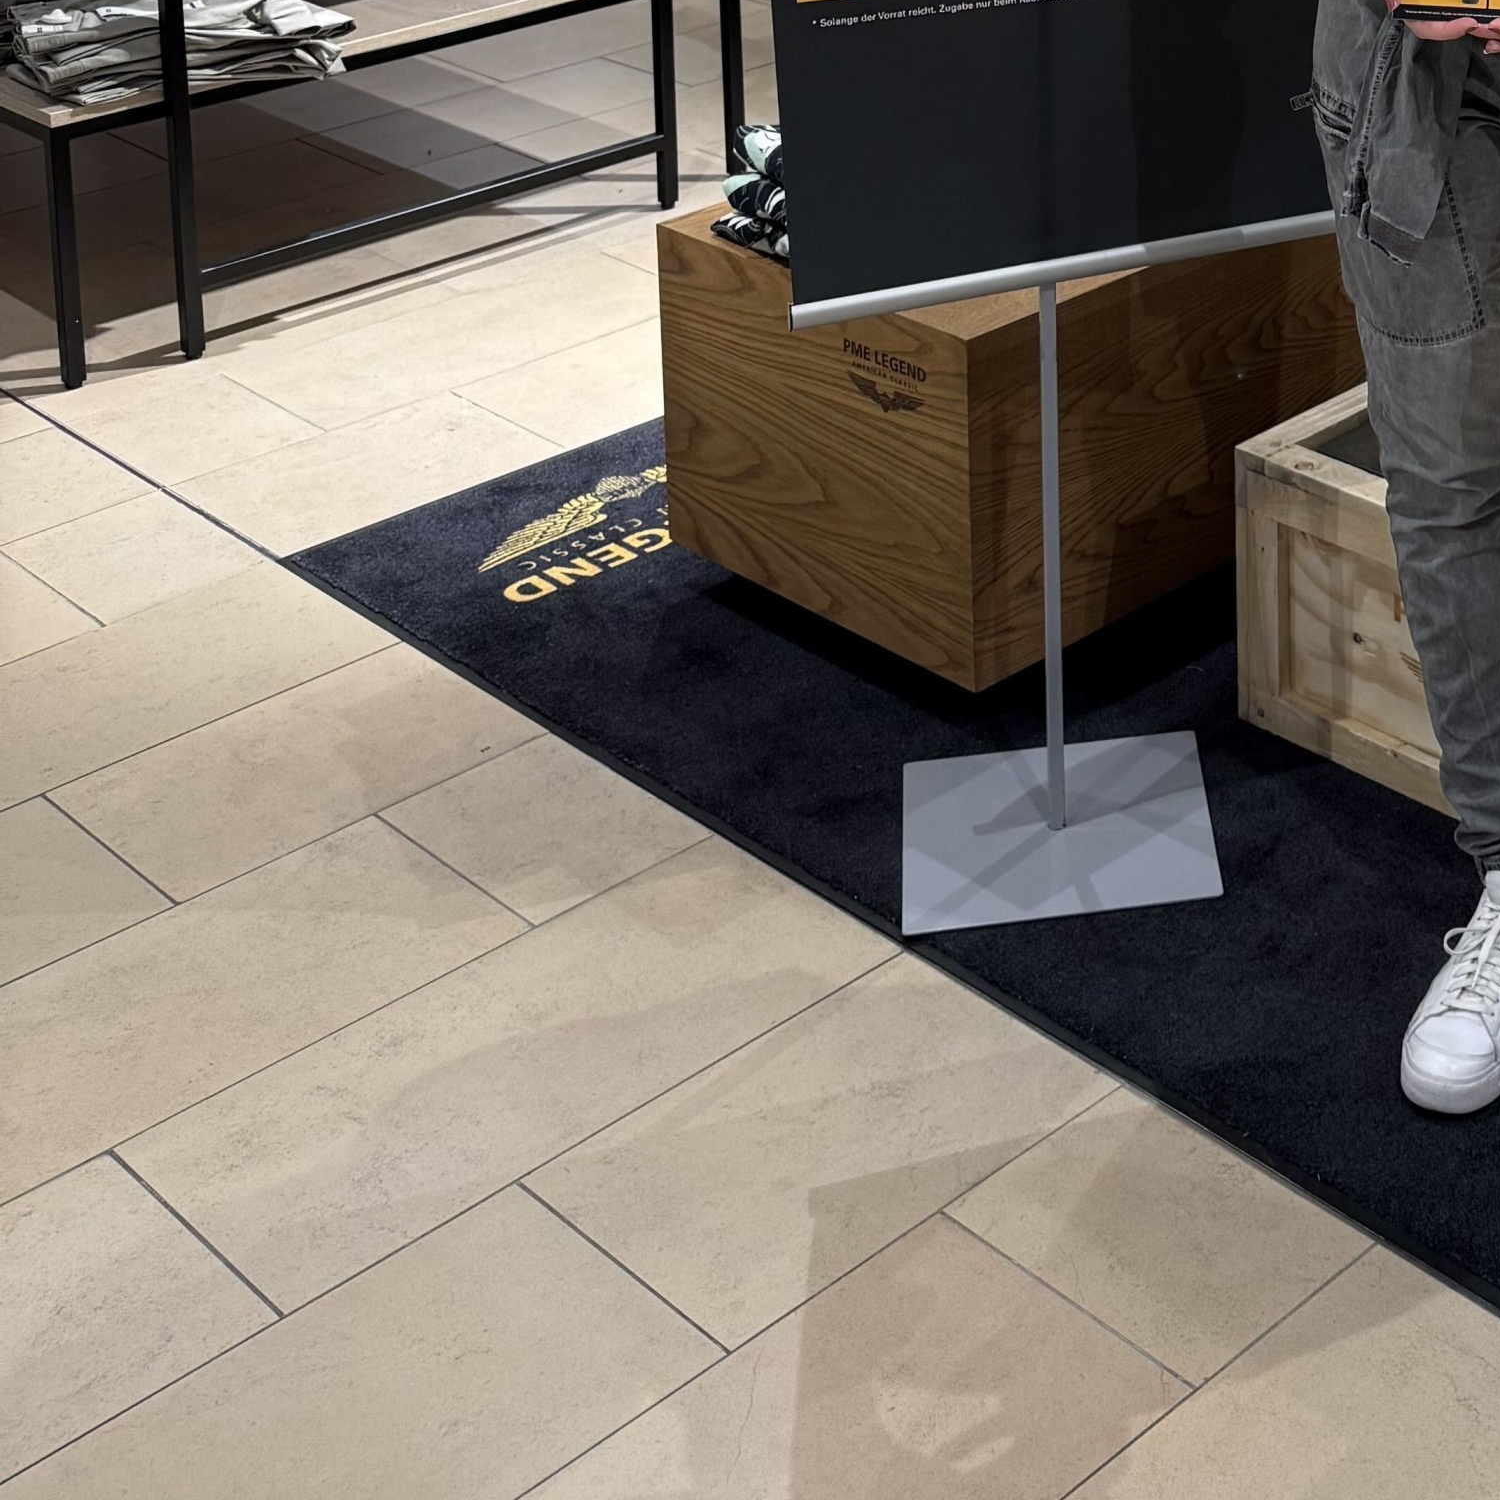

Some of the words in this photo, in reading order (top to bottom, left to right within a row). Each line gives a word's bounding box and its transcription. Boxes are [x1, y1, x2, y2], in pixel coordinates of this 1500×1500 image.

[820, 16, 858, 28] Solange
[861, 13, 876, 22] der
[878, 9, 906, 20] Vorrat
[908, 5, 937, 17] reicht.
[939, 1, 974, 14] Zugabe
[976, 0, 991, 9] nur
[843, 337, 871, 361] PME
[874, 350, 926, 382] LEGEND
[503, 528, 673, 603] GEND
[518, 518, 642, 571] CLASSIC
